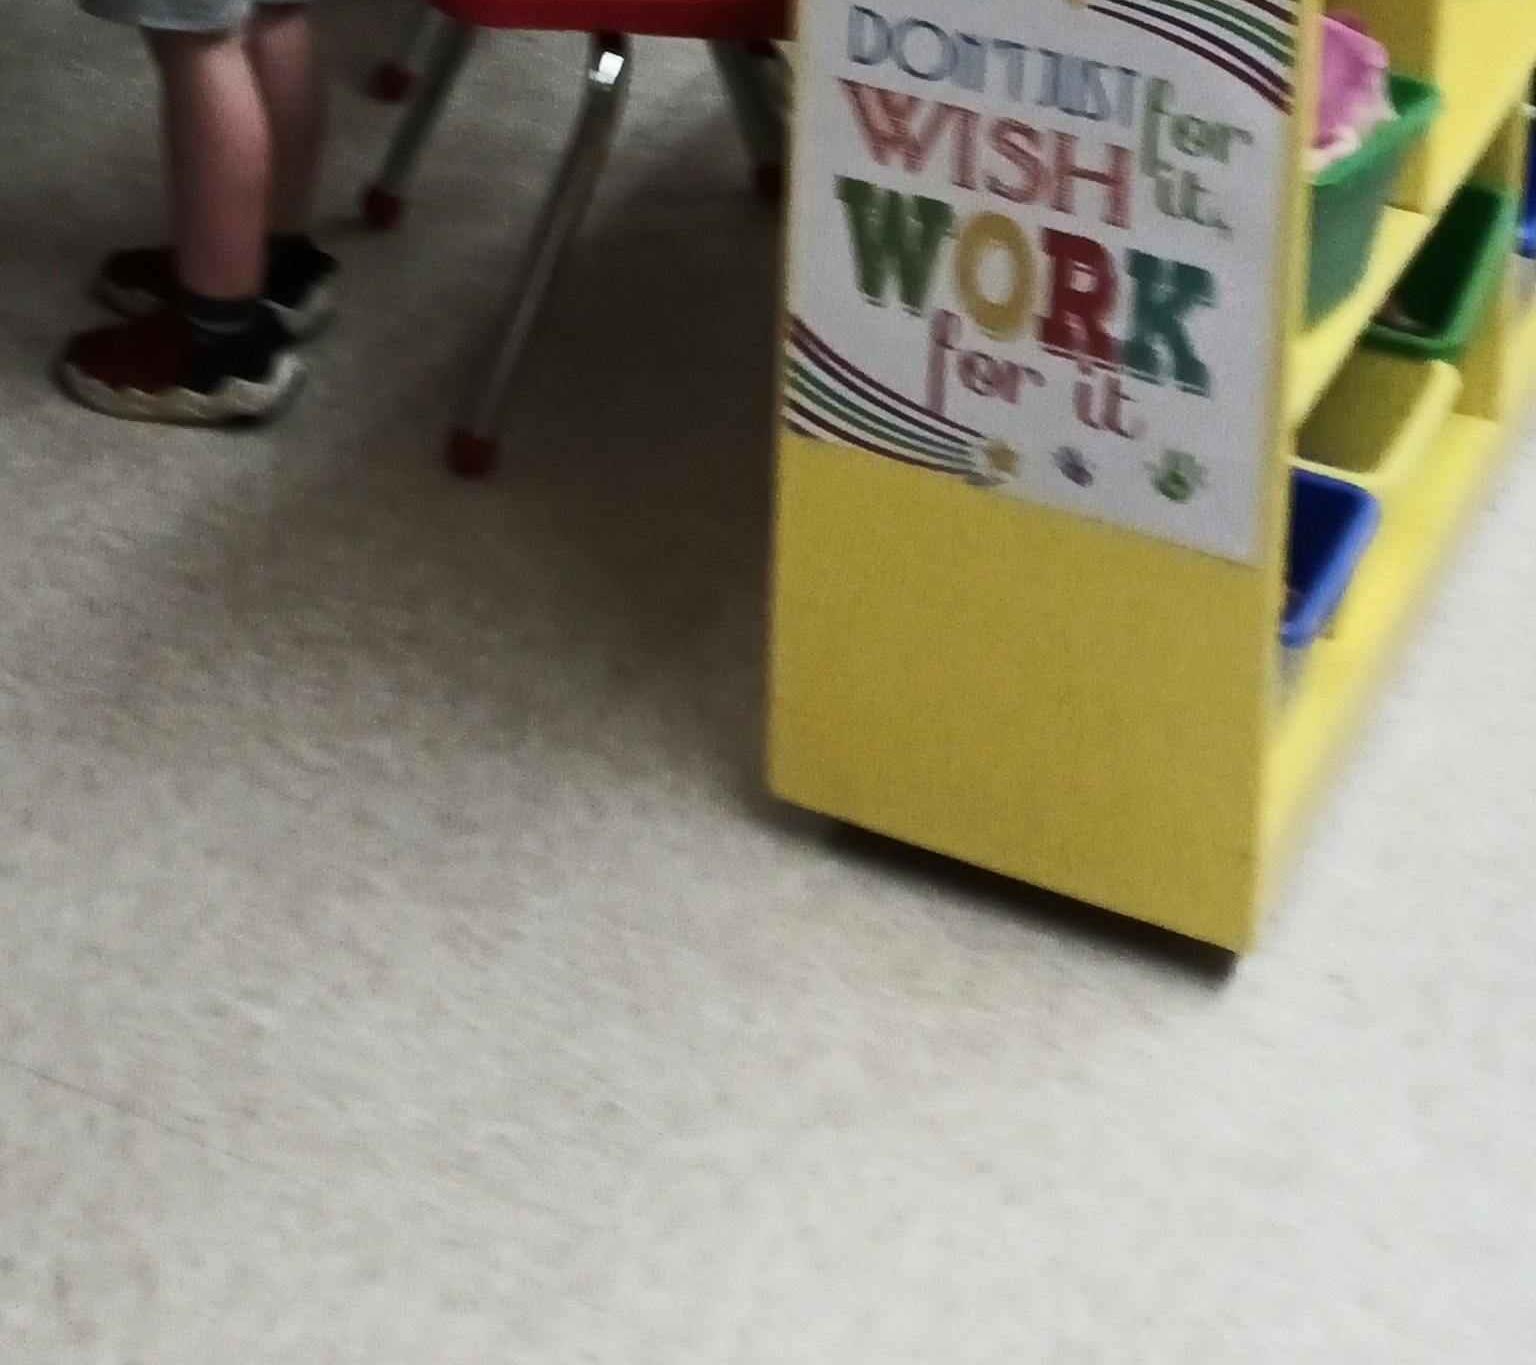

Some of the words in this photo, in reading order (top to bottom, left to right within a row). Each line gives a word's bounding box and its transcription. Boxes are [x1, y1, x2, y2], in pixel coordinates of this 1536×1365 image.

[836, 77, 1134, 230] WISH
[1140, 77, 1255, 179] for
[834, 174, 1216, 397] WORK
[925, 308, 1047, 415] for
